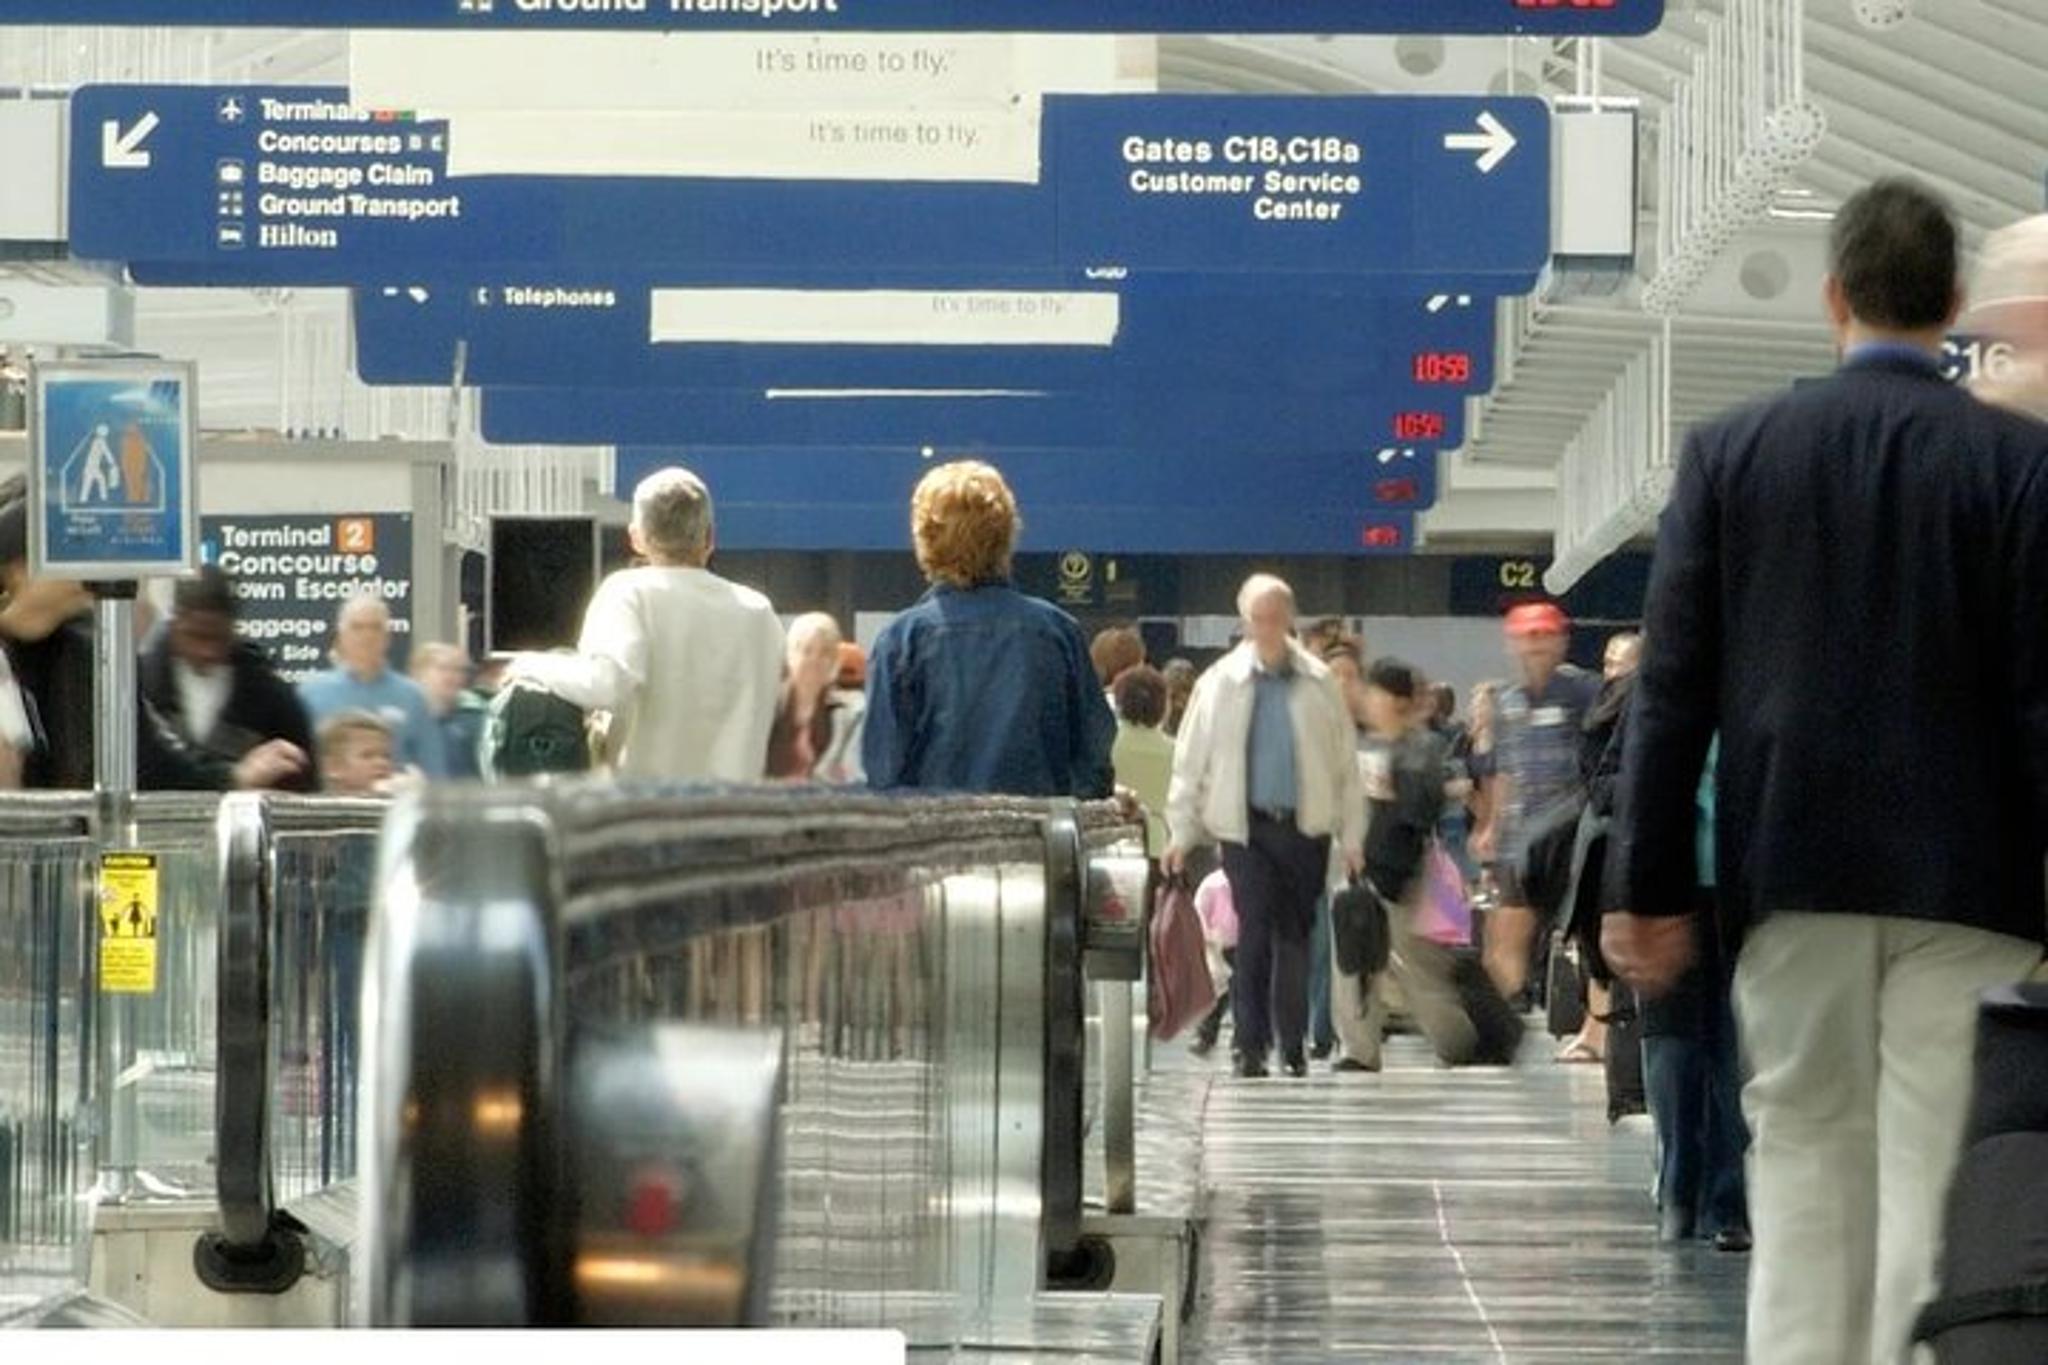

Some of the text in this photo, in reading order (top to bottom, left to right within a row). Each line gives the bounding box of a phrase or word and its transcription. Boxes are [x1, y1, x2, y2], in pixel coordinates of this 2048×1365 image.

[807, 50, 866, 71] time
[878, 50, 905, 72] to
[258, 130, 401, 153] Concourses
[855, 122, 908, 142] time
[917, 122, 940, 144] to
[1122, 136, 1361, 166] Gates C18,C18a
[258, 162, 434, 189] Baggage Claim
[1130, 169, 1361, 193] Customer Service
[258, 193, 460, 220] Ground Transport
[1253, 196, 1342, 220] Center
[259, 224, 338, 248] Hilton
[504, 287, 616, 308] Telephones
[221, 522, 363, 547] Terminal 2
[218, 552, 378, 574] Concourse
[231, 583, 286, 600] own
[232, 619, 327, 638] aggage
